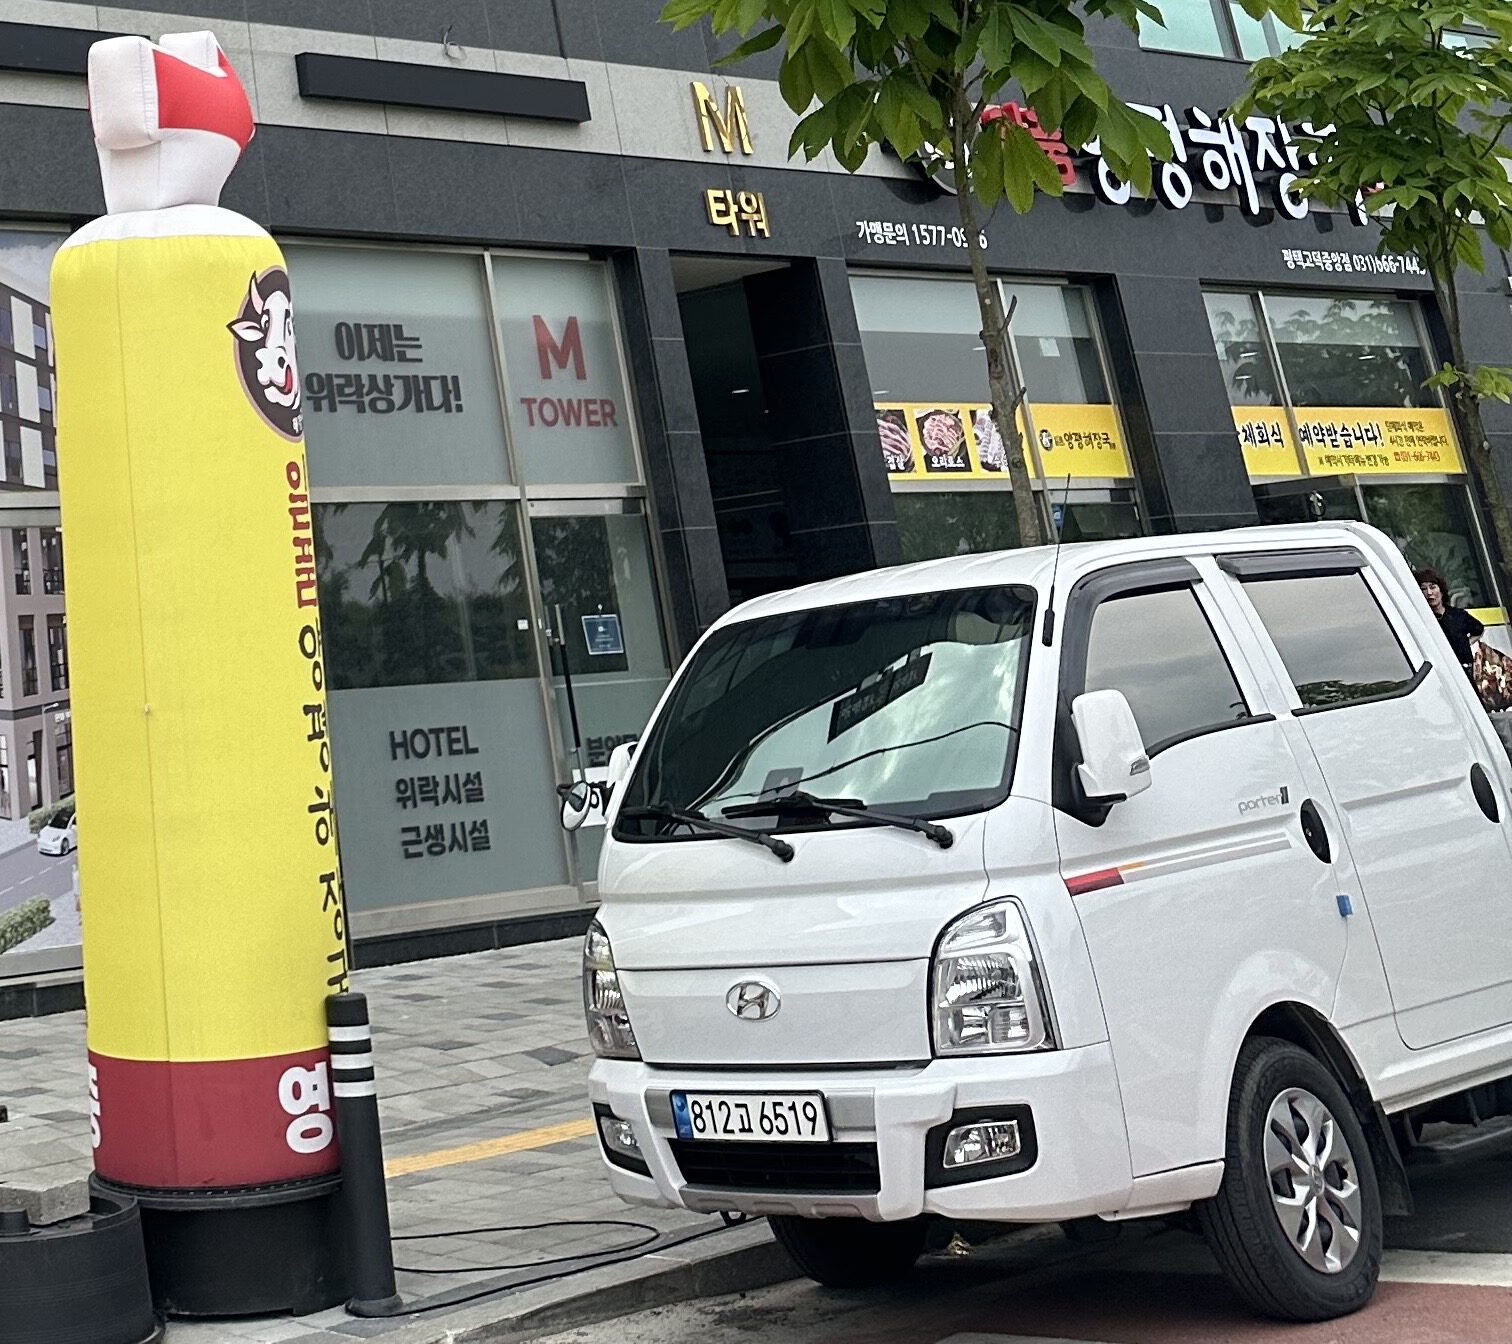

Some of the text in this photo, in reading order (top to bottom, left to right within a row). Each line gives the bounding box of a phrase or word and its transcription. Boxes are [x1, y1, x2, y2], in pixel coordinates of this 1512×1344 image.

[692, 81, 754, 155] M
[705, 188, 771, 239] 타워
[855, 219, 910, 246] 가맹문의
[334, 321, 423, 363] 이제는
[532, 314, 587, 381] M
[304, 372, 464, 414] 위락상가다!
[520, 396, 619, 428] TOWER
[1240, 421, 1385, 449] 체회식 예약받습니다!
[931, 453, 965, 469] 오리로스
[389, 725, 480, 761] HOTEL
[395, 770, 485, 810] 위락시설
[400, 818, 491, 860] 근생시설
[690, 1099, 818, 1136] 812고 6519
